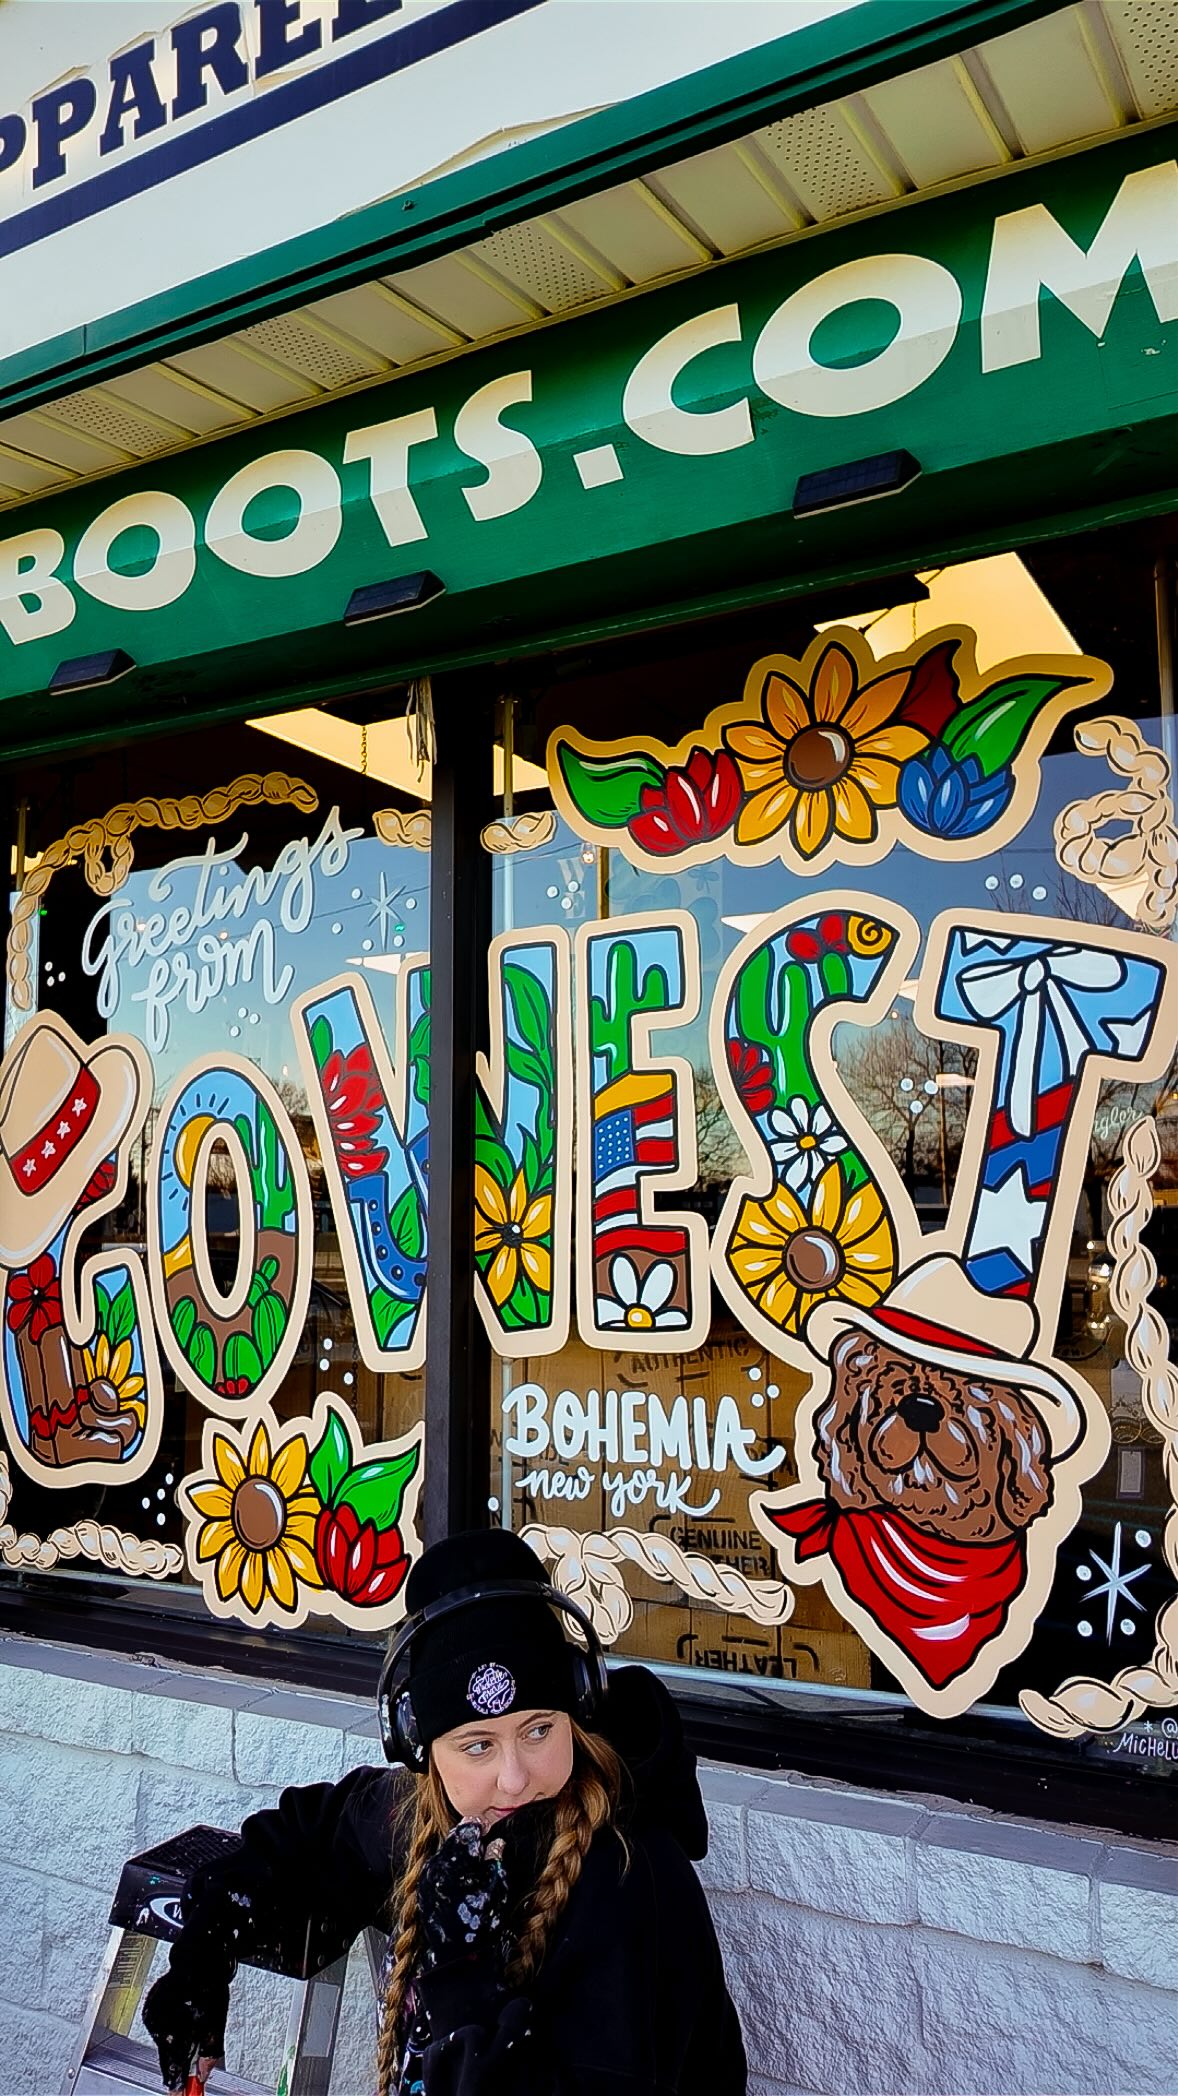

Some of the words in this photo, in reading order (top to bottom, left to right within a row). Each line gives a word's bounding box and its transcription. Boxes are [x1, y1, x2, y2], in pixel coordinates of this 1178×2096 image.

[0, 159, 1178, 646] BOOTS.COM
[132, 919, 293, 1053] from
[629, 1336, 751, 1373] AUTHENTIC
[501, 1382, 787, 1476] BOHEMIA
[515, 1465, 596, 1501] new
[669, 1525, 763, 1551] GENUINE
